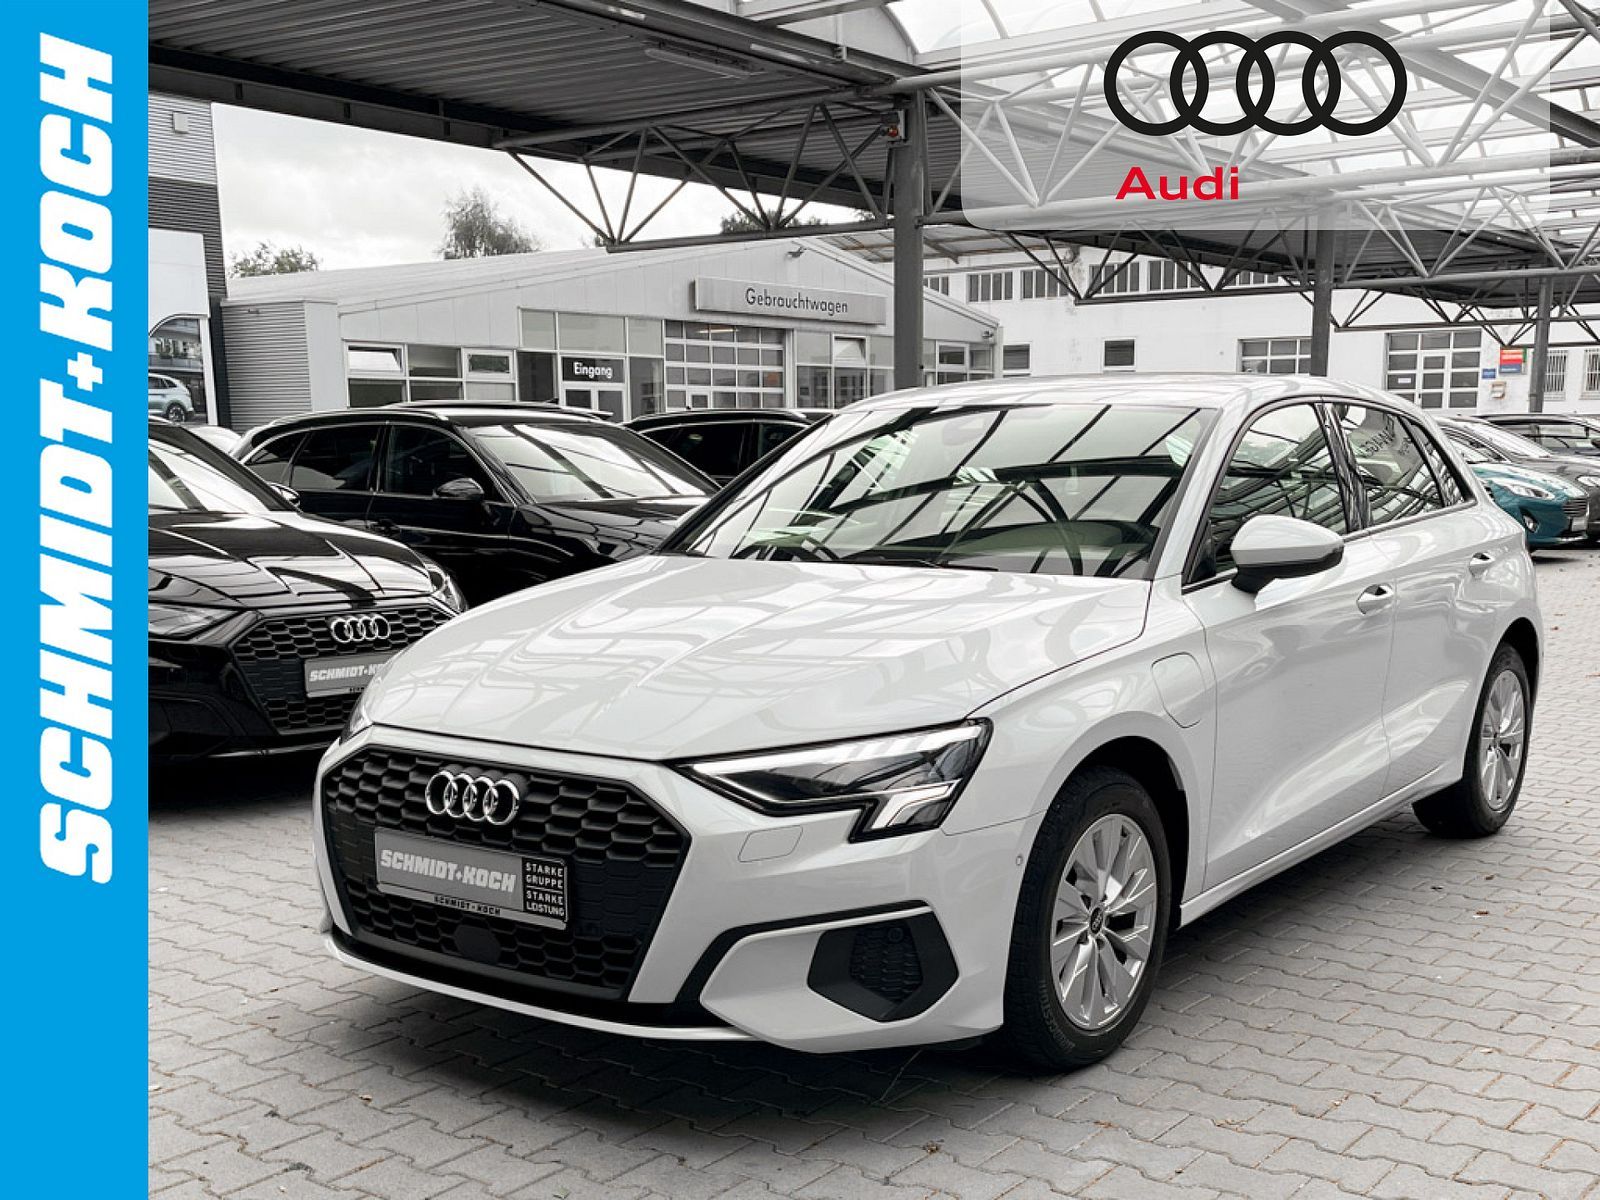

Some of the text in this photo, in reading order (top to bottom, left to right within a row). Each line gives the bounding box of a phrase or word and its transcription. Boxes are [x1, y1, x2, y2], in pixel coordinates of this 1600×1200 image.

[745, 287, 849, 316] Gebrauchtwagen
[573, 362, 613, 379] Eingang
[380, 849, 517, 893] SCHMIDT+KOCH
[526, 862, 563, 877] STARKE
[526, 874, 563, 889] GRUPPE
[526, 890, 563, 905] STARKE
